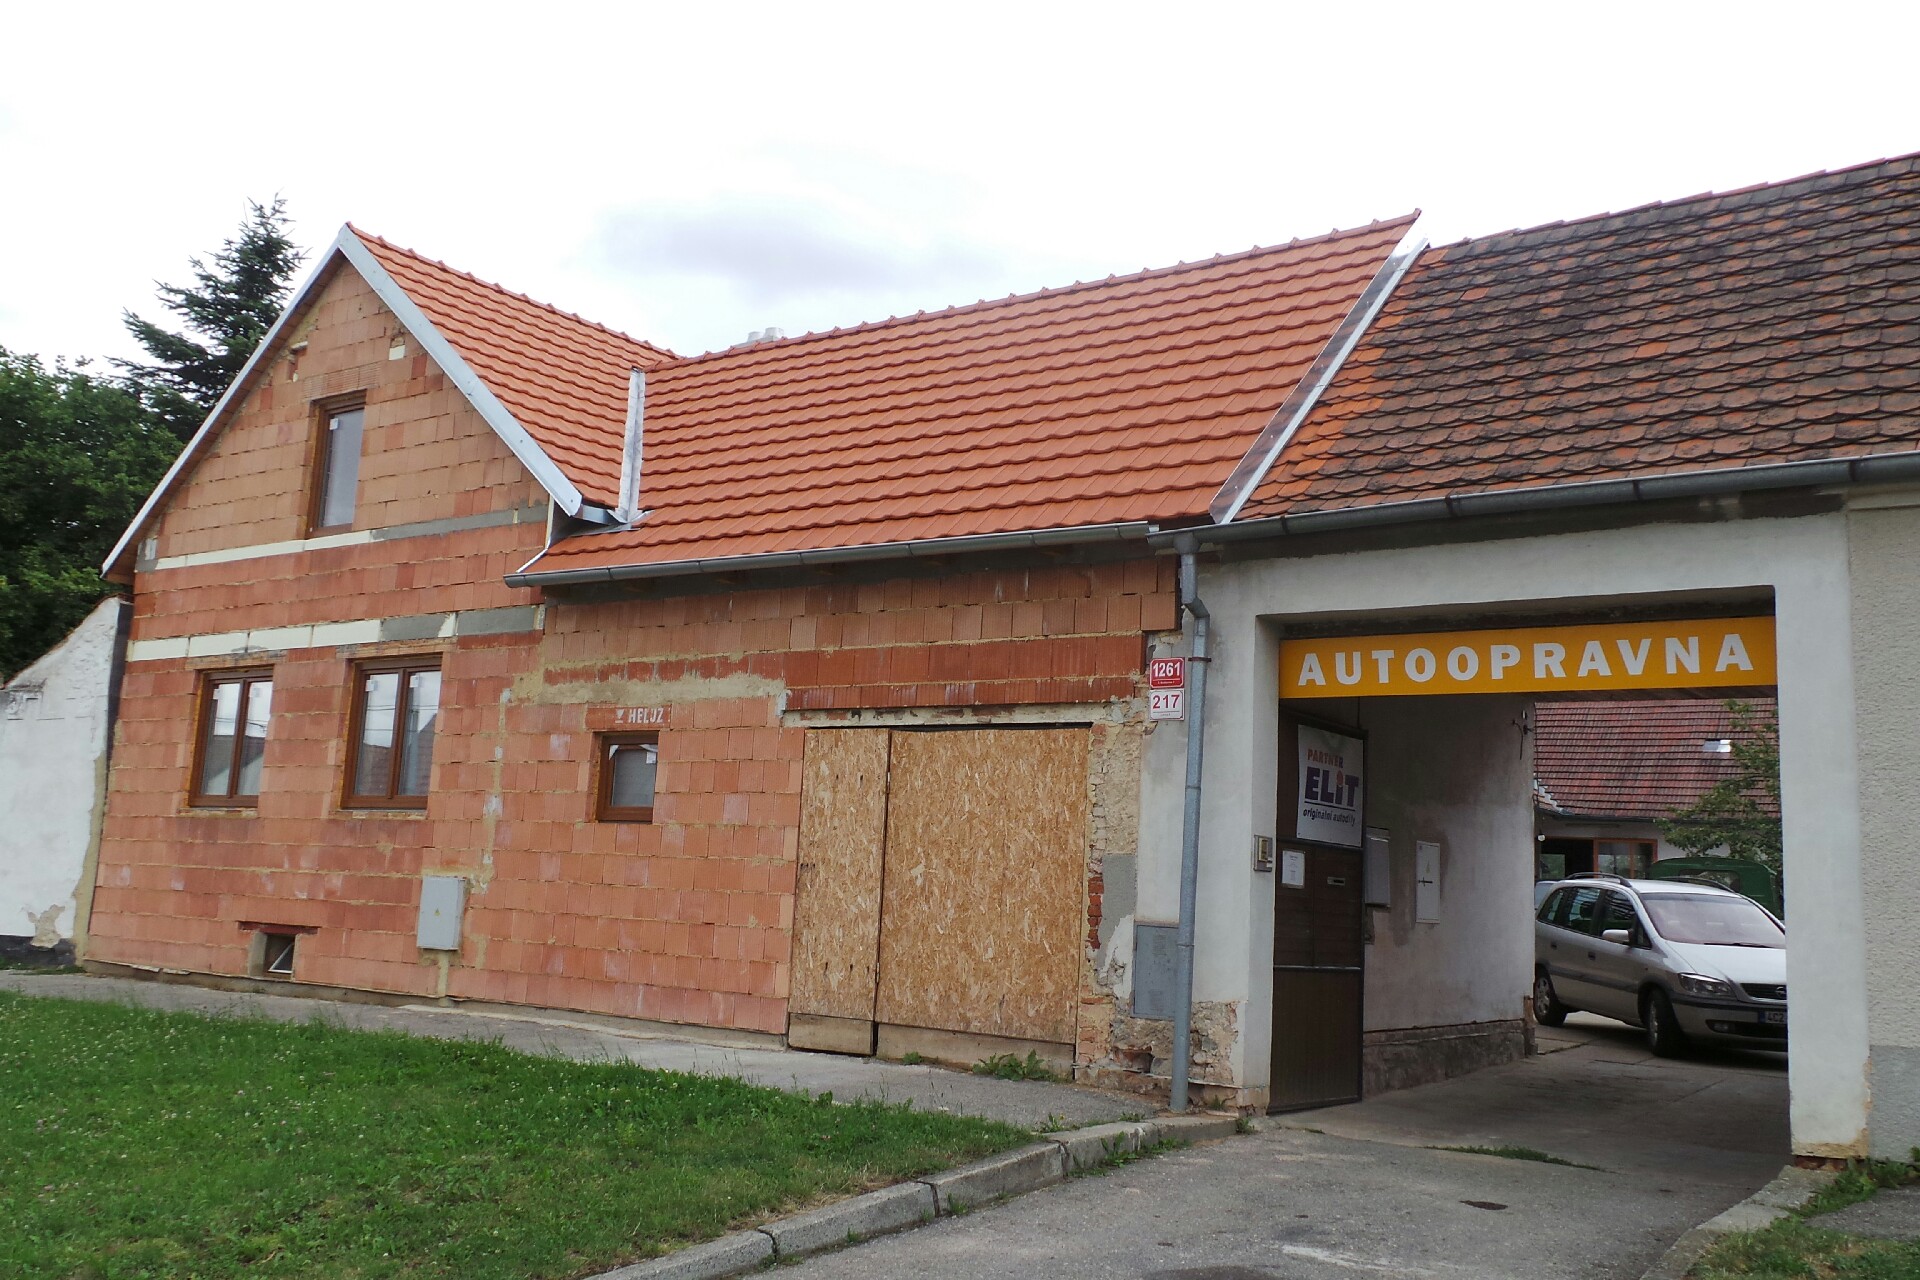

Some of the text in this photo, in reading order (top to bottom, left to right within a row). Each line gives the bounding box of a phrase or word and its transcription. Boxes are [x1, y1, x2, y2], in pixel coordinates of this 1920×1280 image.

[1298, 633, 1754, 686] AUTOOPRAVNA
[1153, 662, 1180, 677] 1261
[1152, 694, 1180, 709] 217
[1307, 748, 1344, 769] PARTNER
